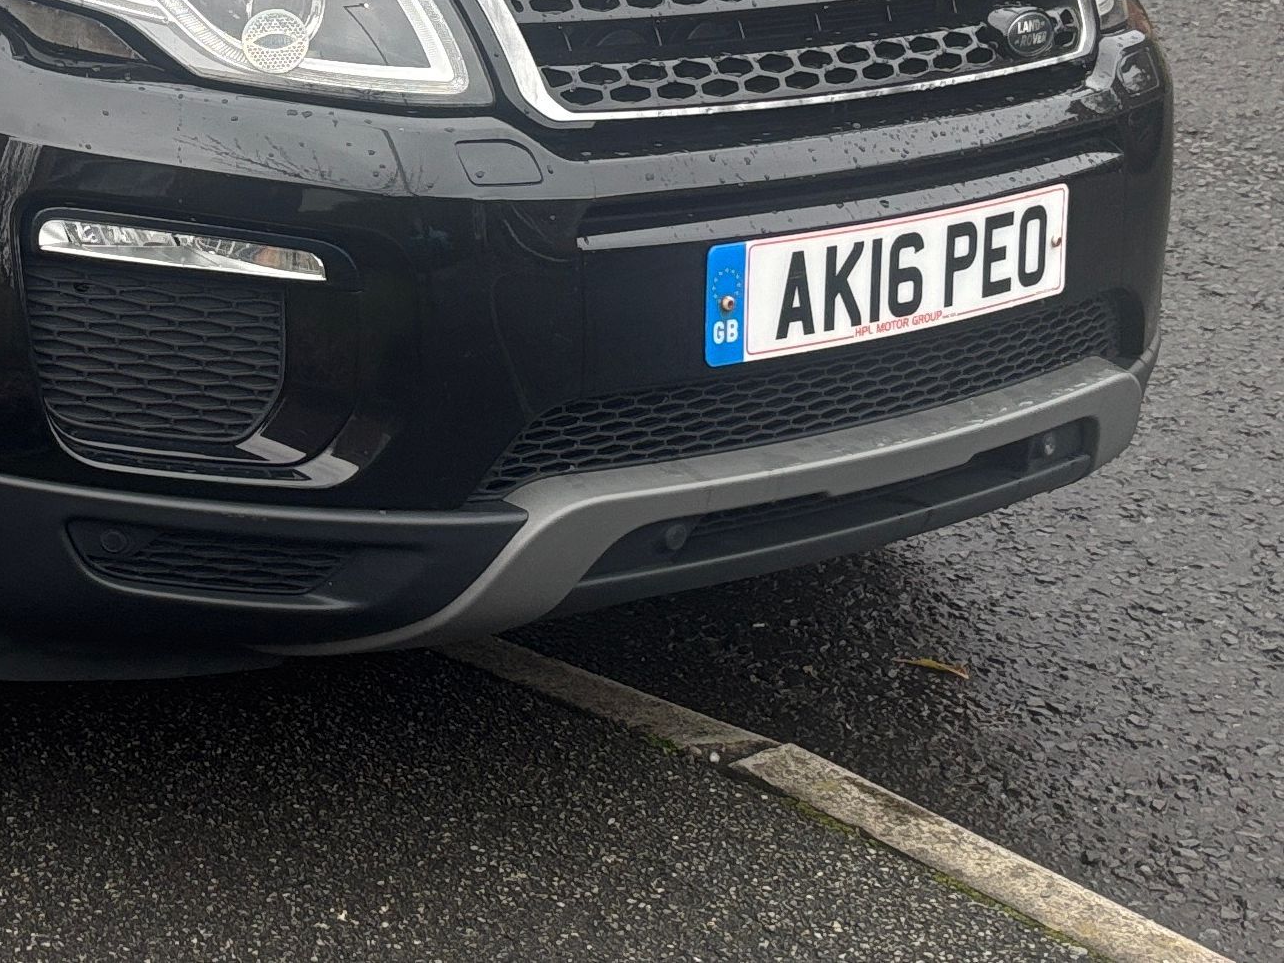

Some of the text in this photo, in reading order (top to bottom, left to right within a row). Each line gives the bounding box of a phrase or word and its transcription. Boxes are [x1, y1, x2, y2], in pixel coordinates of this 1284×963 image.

[775, 205, 1048, 340] AK16 PEO
[713, 319, 738, 344] GB
[855, 310, 943, 338] HPL MOTOR GROUP
